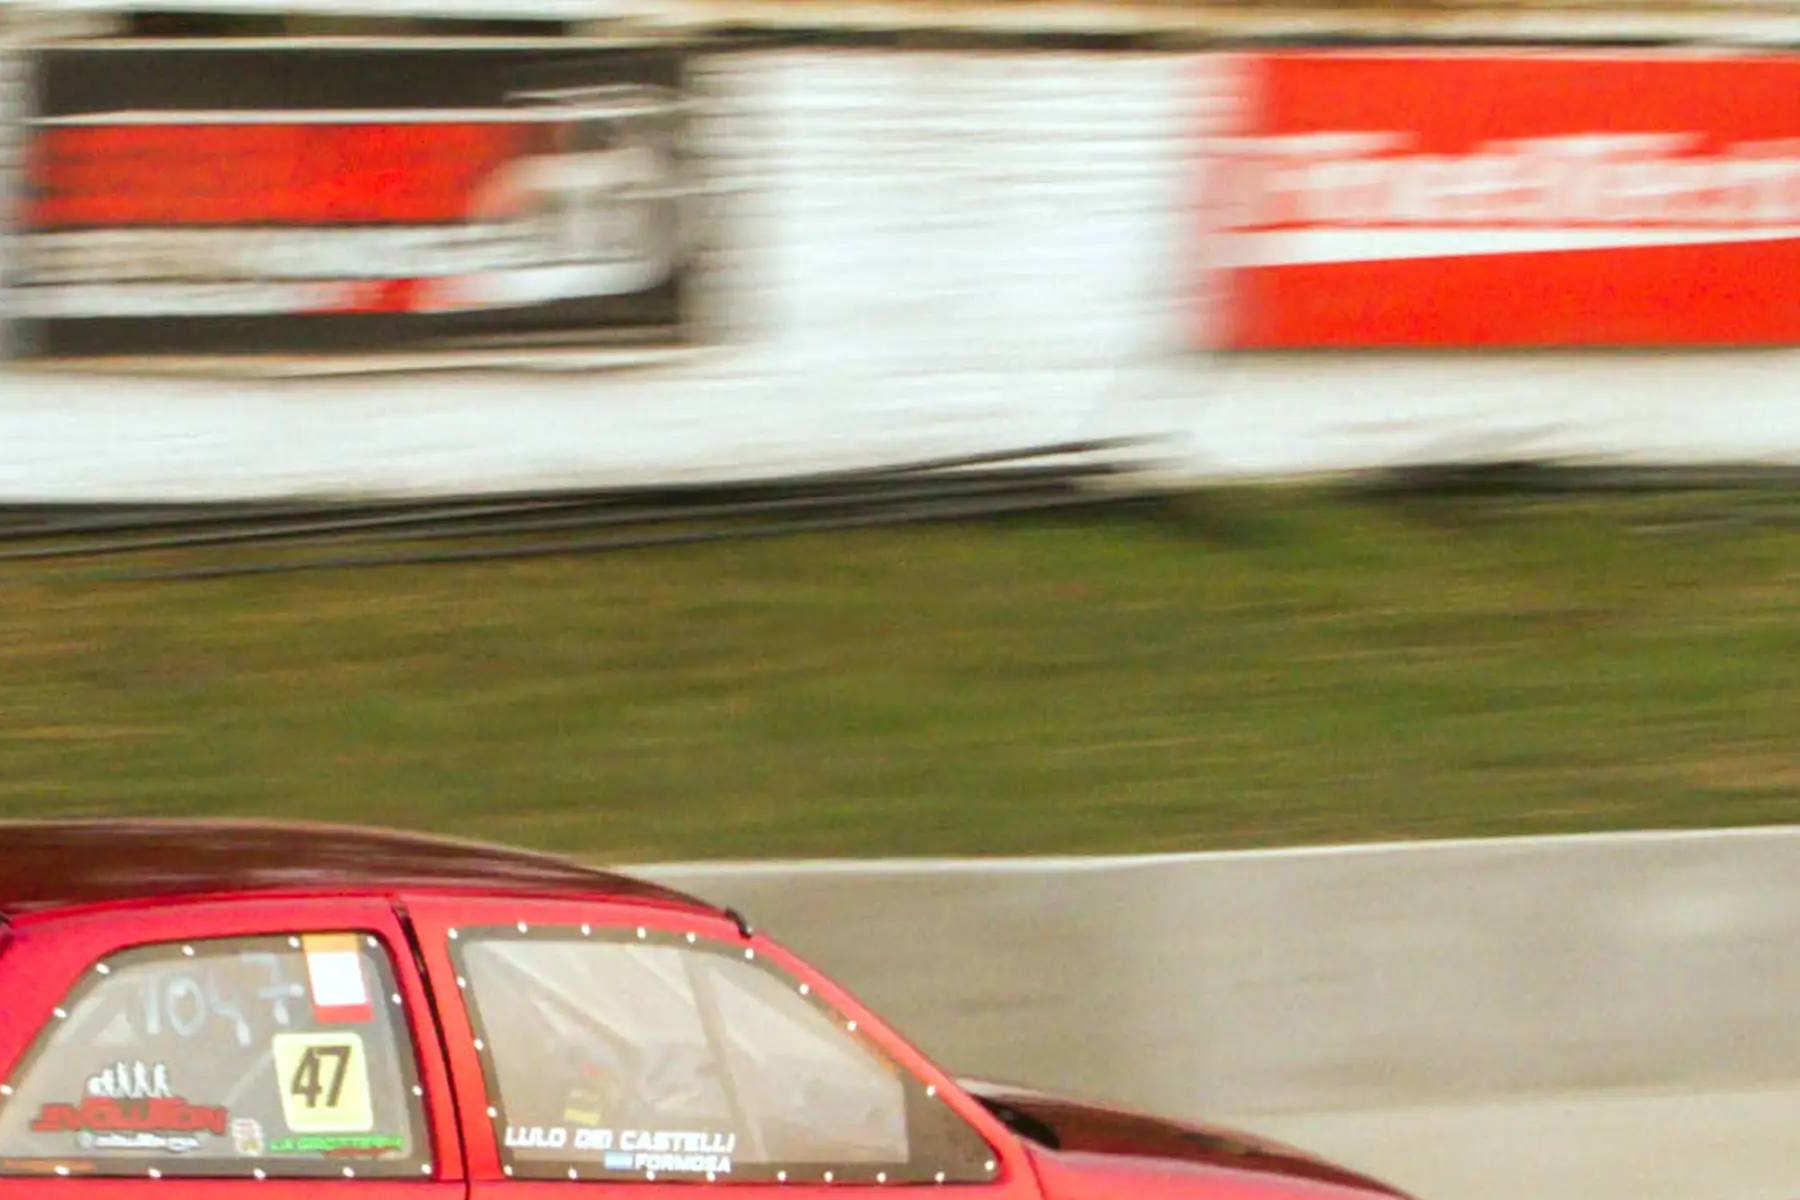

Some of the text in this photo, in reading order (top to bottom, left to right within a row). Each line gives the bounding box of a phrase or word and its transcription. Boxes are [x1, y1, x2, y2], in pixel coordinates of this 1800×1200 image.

[291, 1044, 353, 1109] 47
[620, 1131, 736, 1153] CASTELLI
[634, 1153, 732, 1174] FORMOSA
